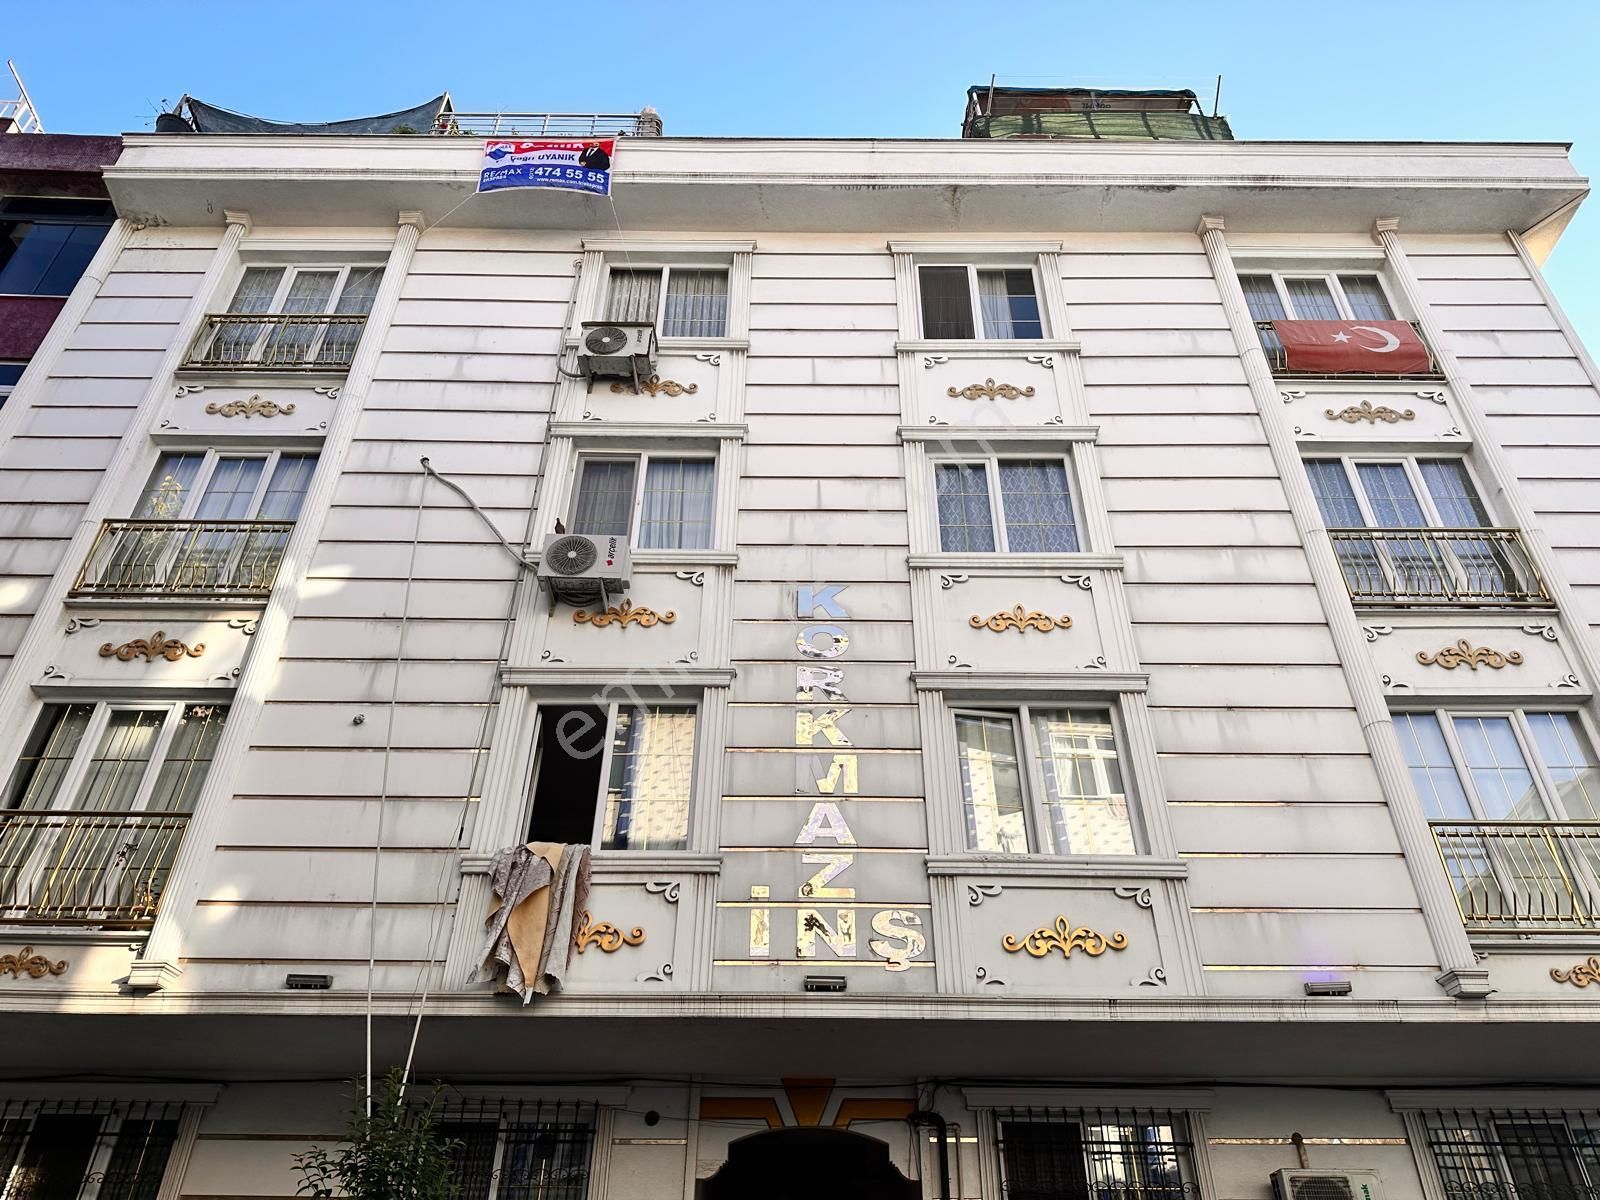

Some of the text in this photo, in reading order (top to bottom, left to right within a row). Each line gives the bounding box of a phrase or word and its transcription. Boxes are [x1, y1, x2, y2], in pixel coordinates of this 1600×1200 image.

[484, 168, 522, 178] RE/MAX
[534, 166, 561, 177] 474
[565, 168, 583, 179] 55
[587, 171, 605, 184] 55
[795, 584, 858, 899] KORKMAZ
[750, 886, 926, 972] İNŞ
